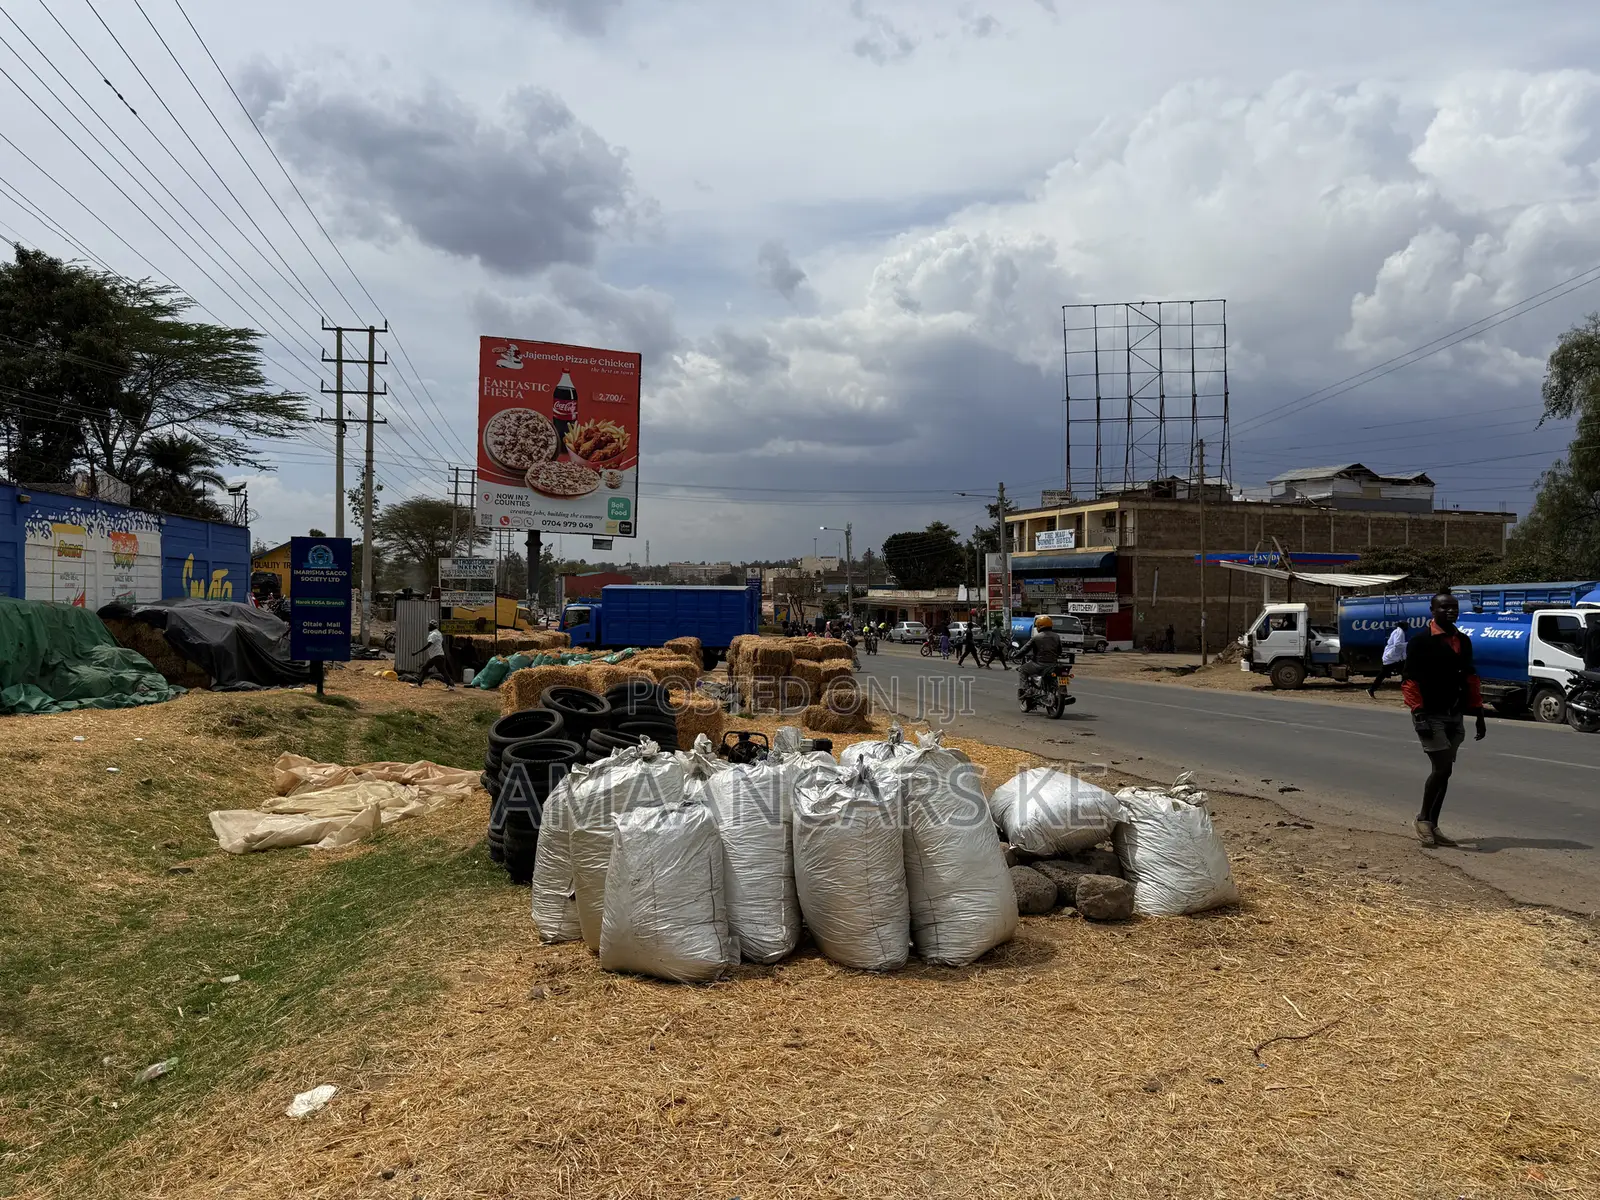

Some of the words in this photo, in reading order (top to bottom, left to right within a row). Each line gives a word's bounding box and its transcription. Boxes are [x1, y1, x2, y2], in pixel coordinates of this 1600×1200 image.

[523, 351, 564, 362] Jajemelo
[566, 355, 588, 364] Pizza
[598, 358, 635, 368] Chicken
[598, 393, 626, 402] 2,700/-
[494, 499, 530, 507] COUNTIES
